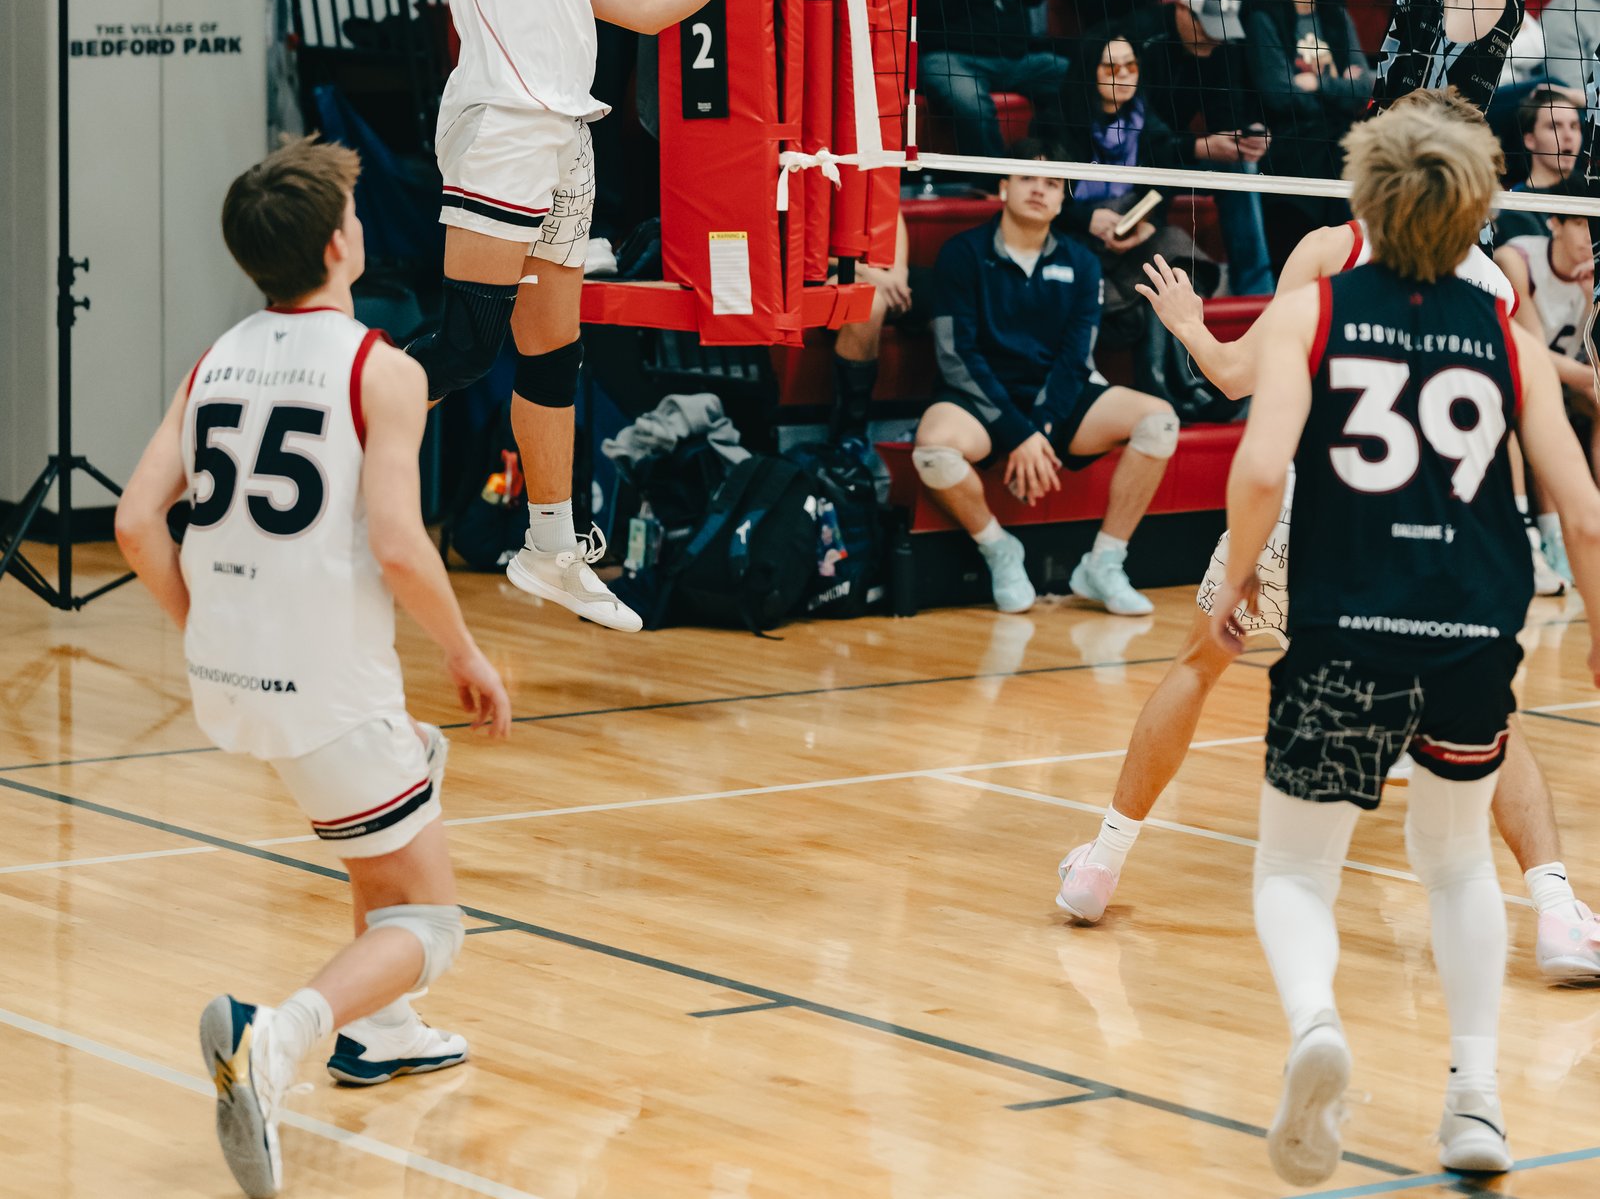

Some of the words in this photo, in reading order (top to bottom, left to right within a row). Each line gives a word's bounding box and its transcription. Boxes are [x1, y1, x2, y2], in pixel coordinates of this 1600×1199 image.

[71, 39, 175, 57] BEDFORD
[184, 37, 242, 54] PARK
[96, 25, 124, 35] THE
[131, 23, 193, 35] VILLAGE
[200, 22, 218, 33] OF
[692, 22, 715, 69] 2
[1343, 322, 1496, 361] 630VLEYBALL
[1328, 355, 1507, 504] 39
[187, 398, 332, 542] 55
